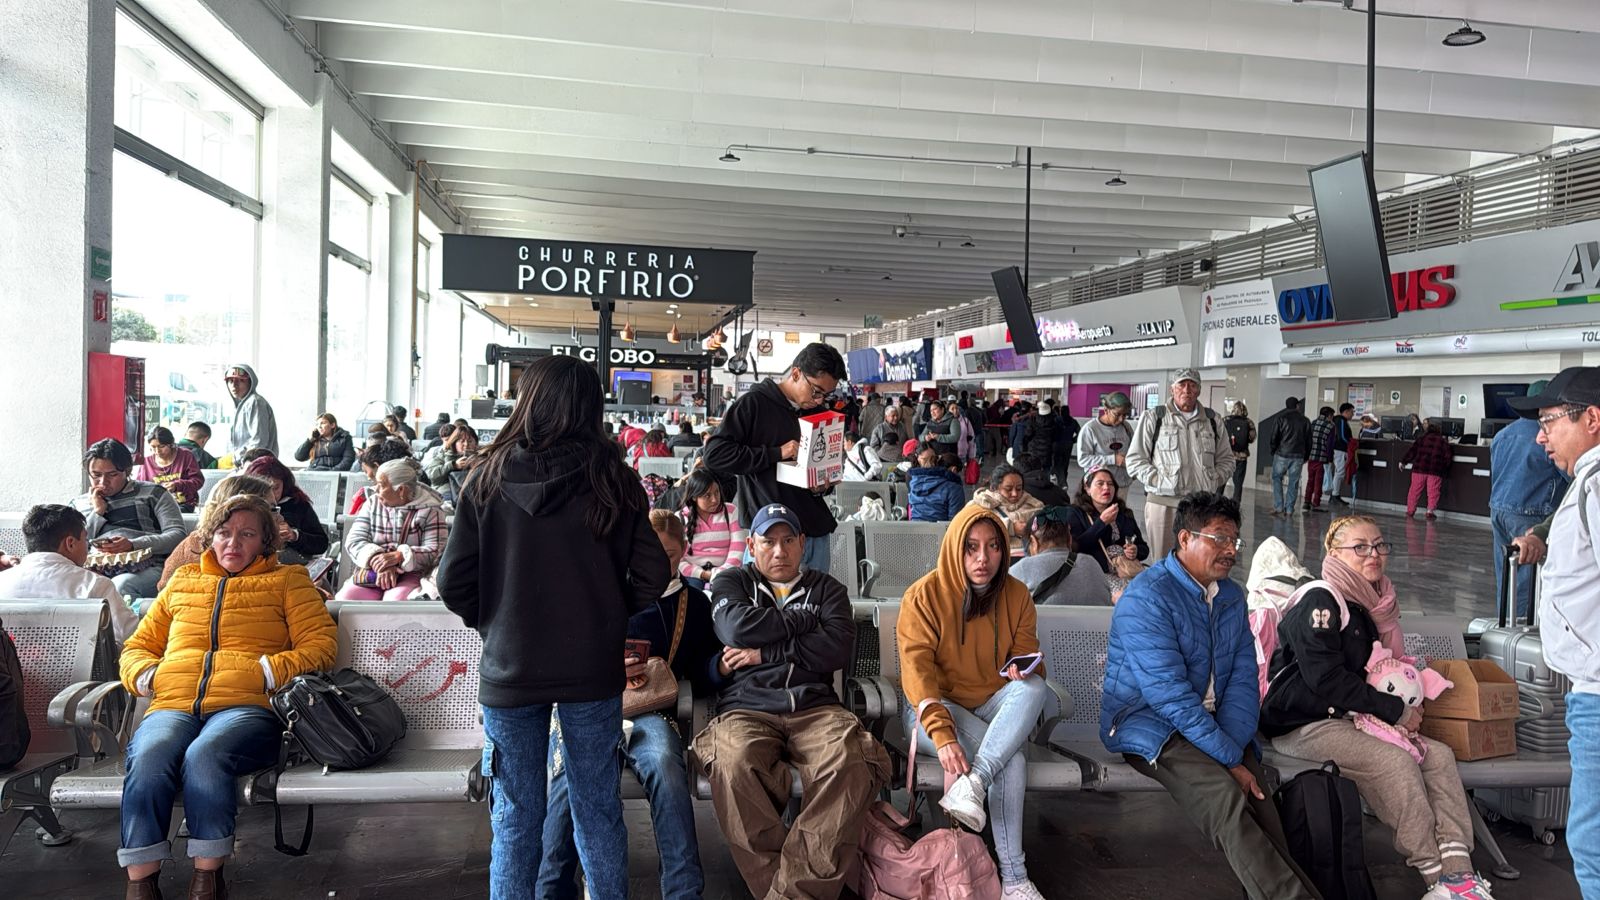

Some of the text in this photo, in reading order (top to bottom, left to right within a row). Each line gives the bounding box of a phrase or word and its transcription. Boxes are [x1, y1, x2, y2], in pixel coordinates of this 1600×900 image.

[518, 246, 695, 269] CHURRERIA
[518, 264, 694, 298] PORFIRIO
[1136, 320, 1172, 336] SALA VIP
[1202, 314, 1278, 332] OFICINAS GENERALES
[579, 347, 655, 365] GOBO
[885, 357, 917, 382] Domino's
[828, 432, 842, 444] BOX
